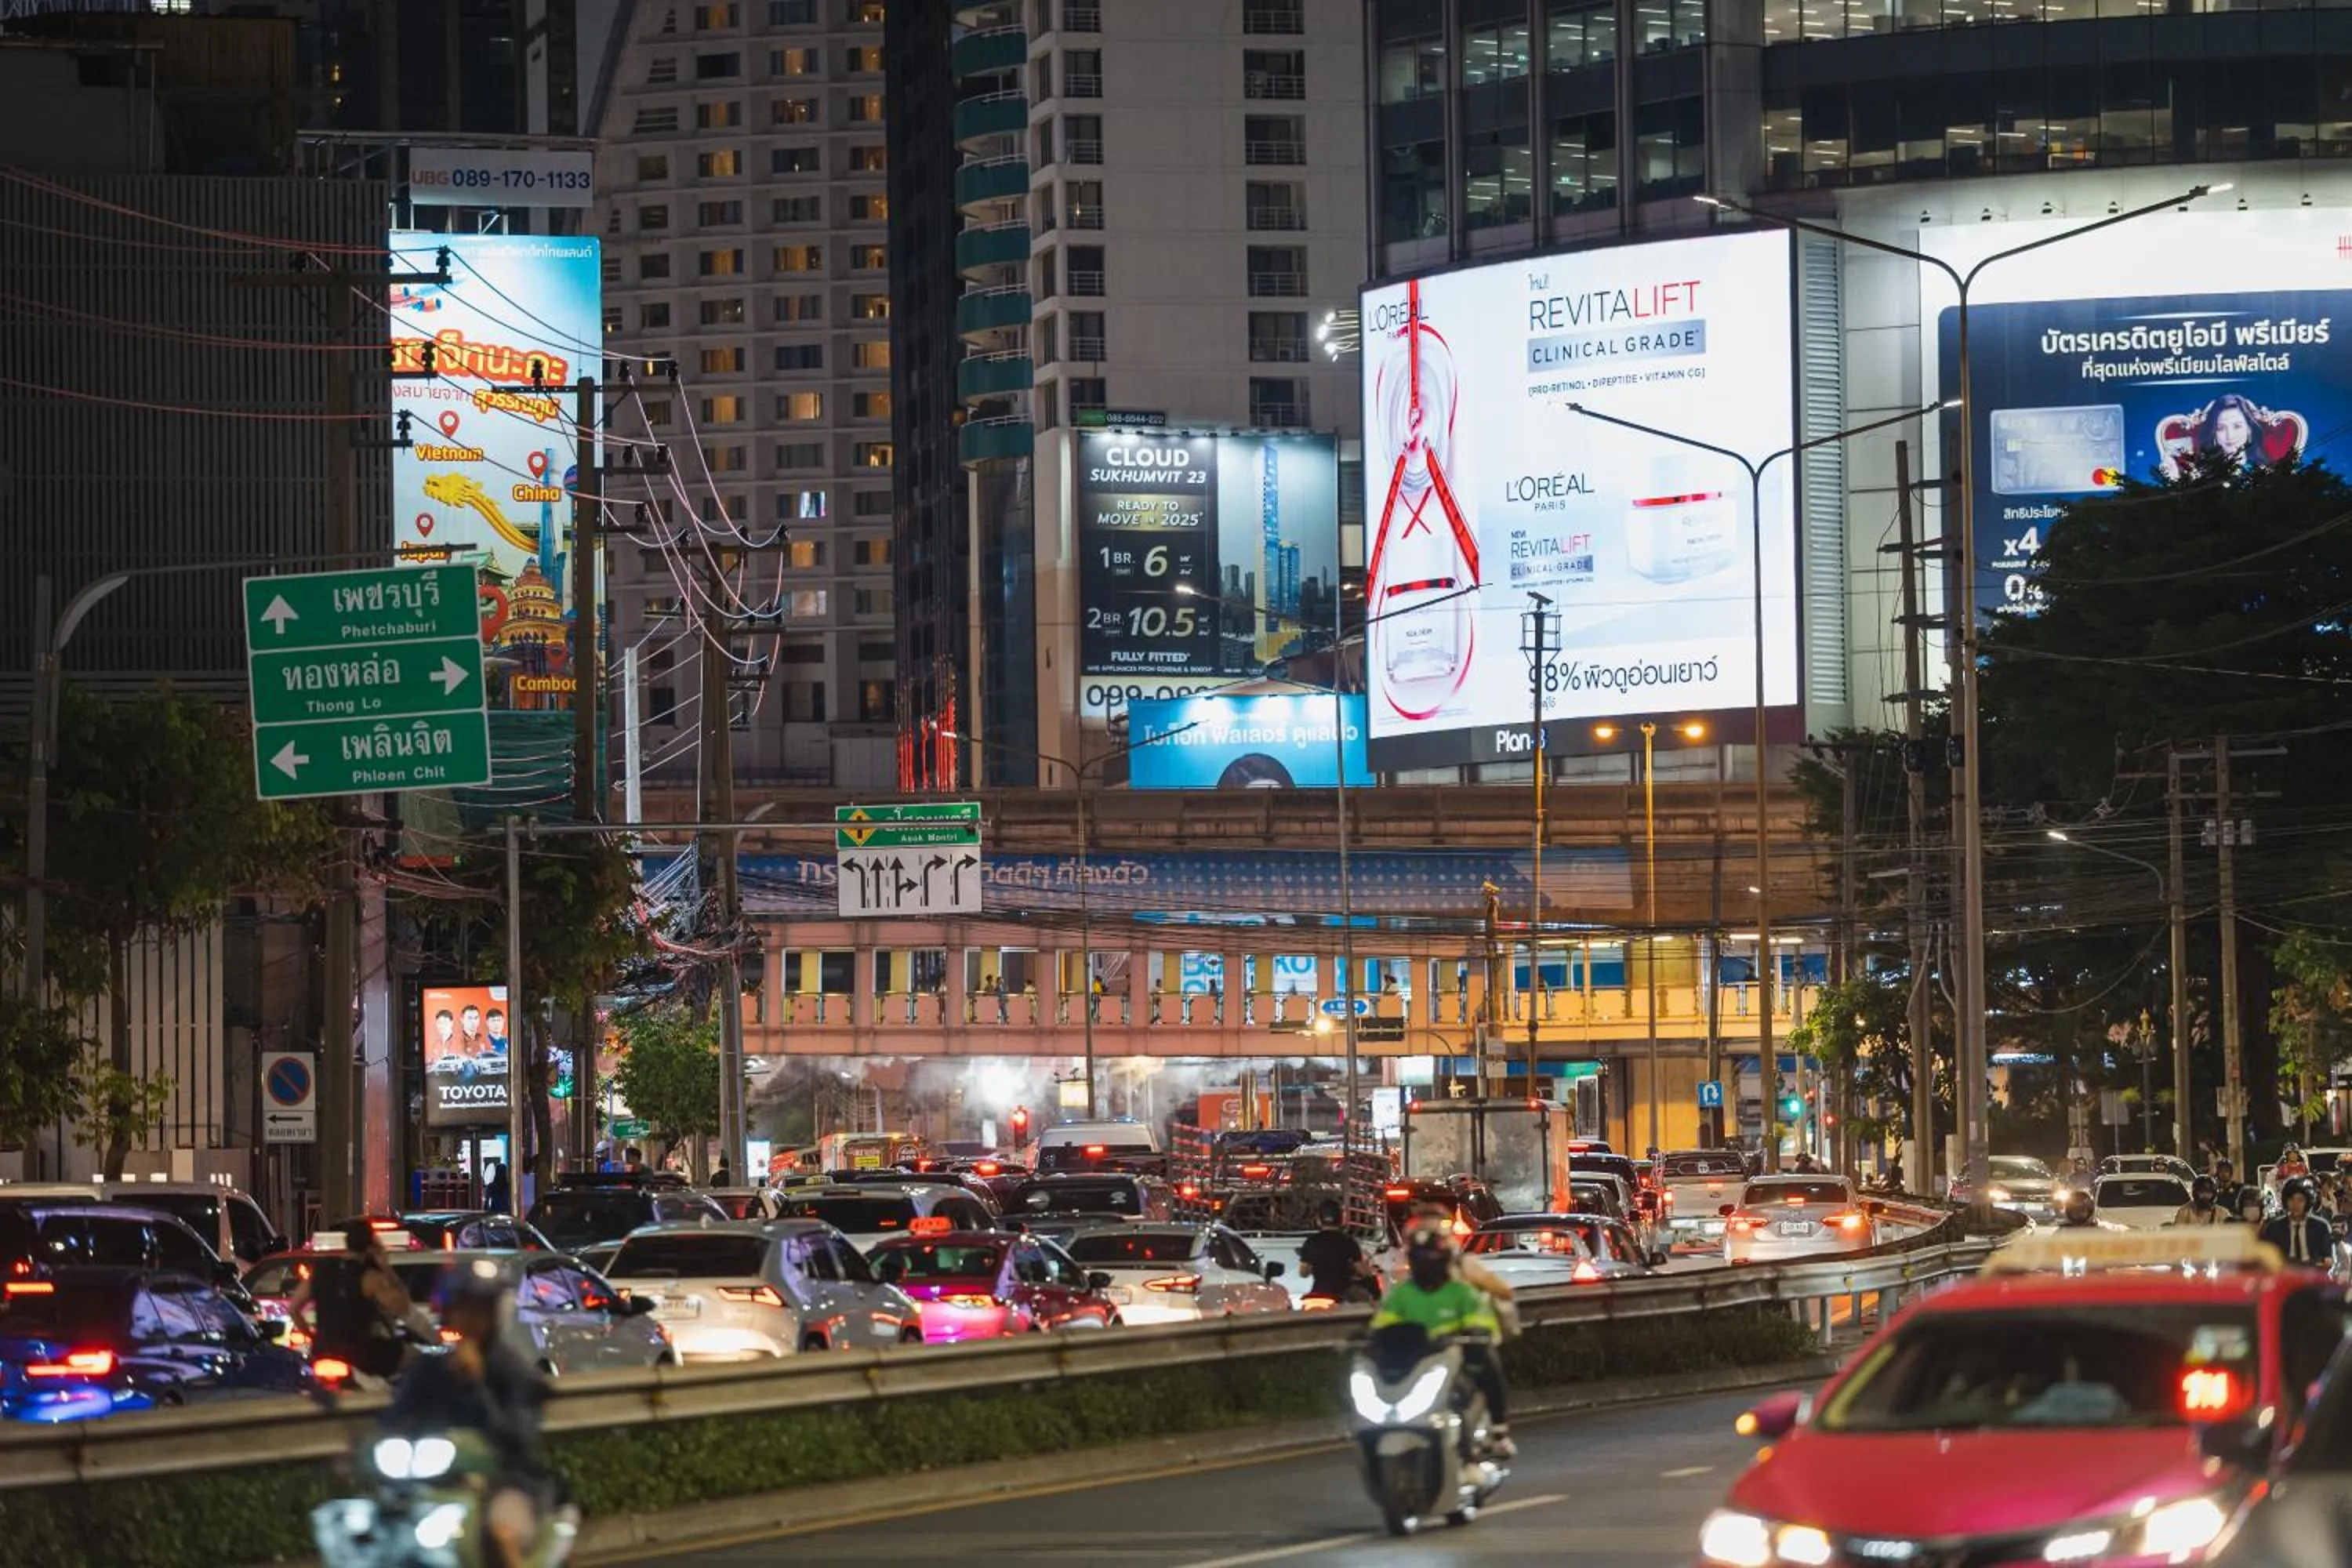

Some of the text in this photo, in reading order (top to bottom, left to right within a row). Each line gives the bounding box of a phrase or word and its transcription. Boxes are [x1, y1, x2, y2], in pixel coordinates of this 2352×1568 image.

[412, 169, 590, 189] UBG 089-170-1133
[1529, 280, 1701, 331] REVITALIFT
[2042, 317, 2332, 356] บัตรเครดิตยูโอบี พรีเมียร์
[1532, 339, 1618, 364] CLINICAL
[1645, 369, 1685, 383] VITAMIN
[415, 444, 484, 462] Vietnam
[1105, 448, 1190, 467] CLOUD
[1090, 468, 1207, 484] SUKHUMVIT 23
[512, 485, 562, 503] China
[1506, 470, 1595, 503] L'ORÉAL
[1116, 500, 1179, 511] READY TO
[1534, 501, 1566, 512] PARIS
[1097, 513, 1142, 524] MOVE
[1511, 534, 1592, 560] REVITALIFT
[2003, 526, 2041, 557] x4
[1099, 546, 1110, 569] 1
[1144, 545, 1168, 577] 6
[1511, 563, 1552, 577] CLINICAL
[332, 569, 441, 618] เพชรบุรี
[341, 619, 437, 639] Phetchaburi
[1087, 607, 1102, 629] 2
[1128, 606, 1196, 638] 10.5
[1111, 652, 1145, 662] FULLY
[281, 652, 401, 691] ทองหล่อ
[1583, 655, 1719, 695] ผิวดูอ่อนเยาว์
[306, 698, 382, 714] Thong Lo
[341, 720, 452, 761] เพลินจิต
[353, 766, 446, 783] Phloen Chit
[438, 1084, 508, 1100] TOYOTA
